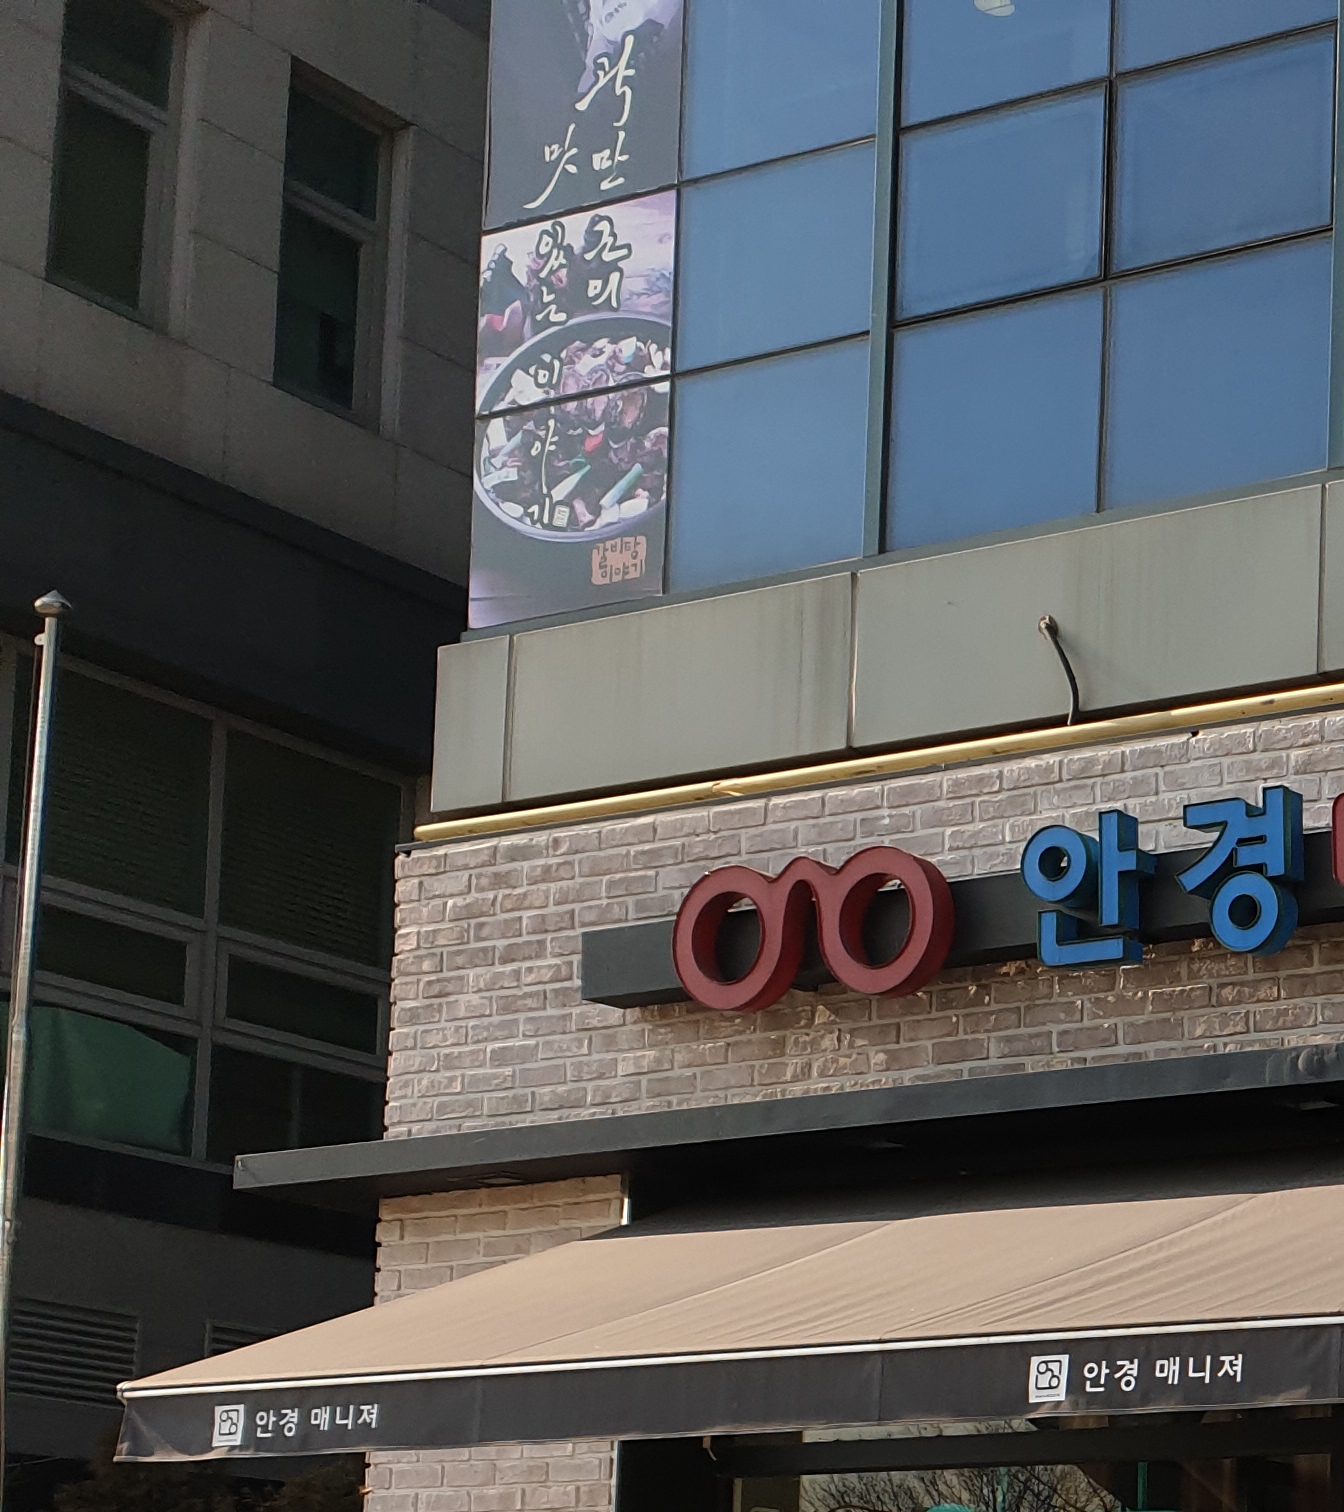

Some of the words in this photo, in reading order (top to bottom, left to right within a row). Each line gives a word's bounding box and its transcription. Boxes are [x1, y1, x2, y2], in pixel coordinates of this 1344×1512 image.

[1083, 1358, 1139, 1393] 안경
[1155, 1353, 1243, 1385] 매니져
[255, 1407, 299, 1438] 안경
[310, 1403, 379, 1431] 매니져
